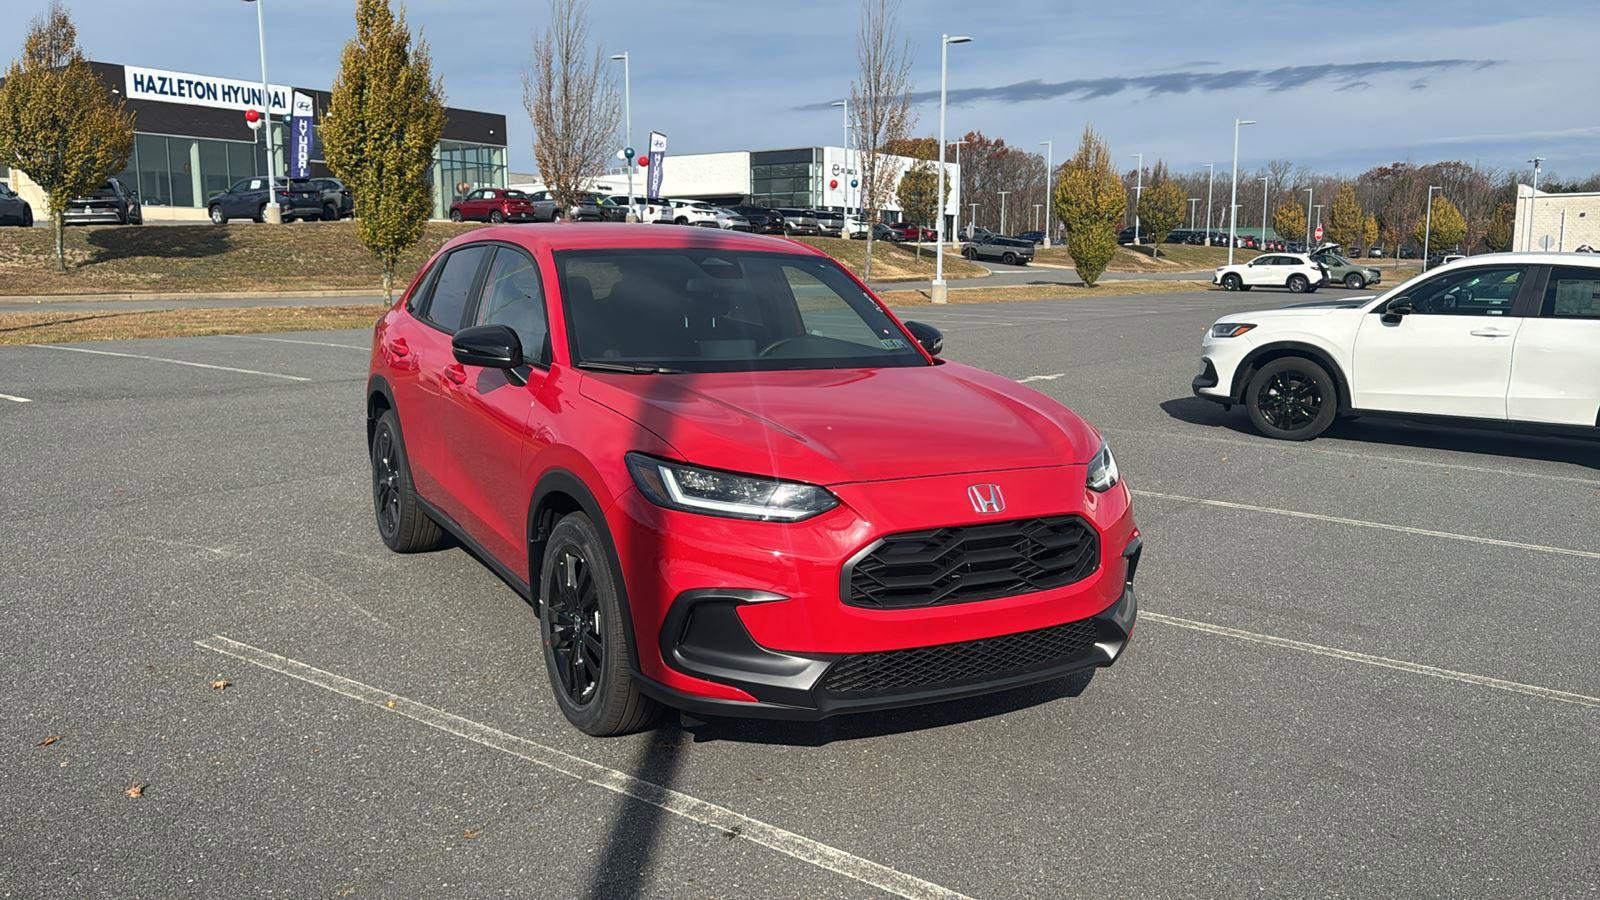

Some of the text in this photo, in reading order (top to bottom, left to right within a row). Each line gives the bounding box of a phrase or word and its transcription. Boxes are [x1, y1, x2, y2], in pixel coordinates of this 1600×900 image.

[133, 73, 286, 109] HAZLETON HYUNDAI
[298, 118, 308, 177] HYUNDAI
